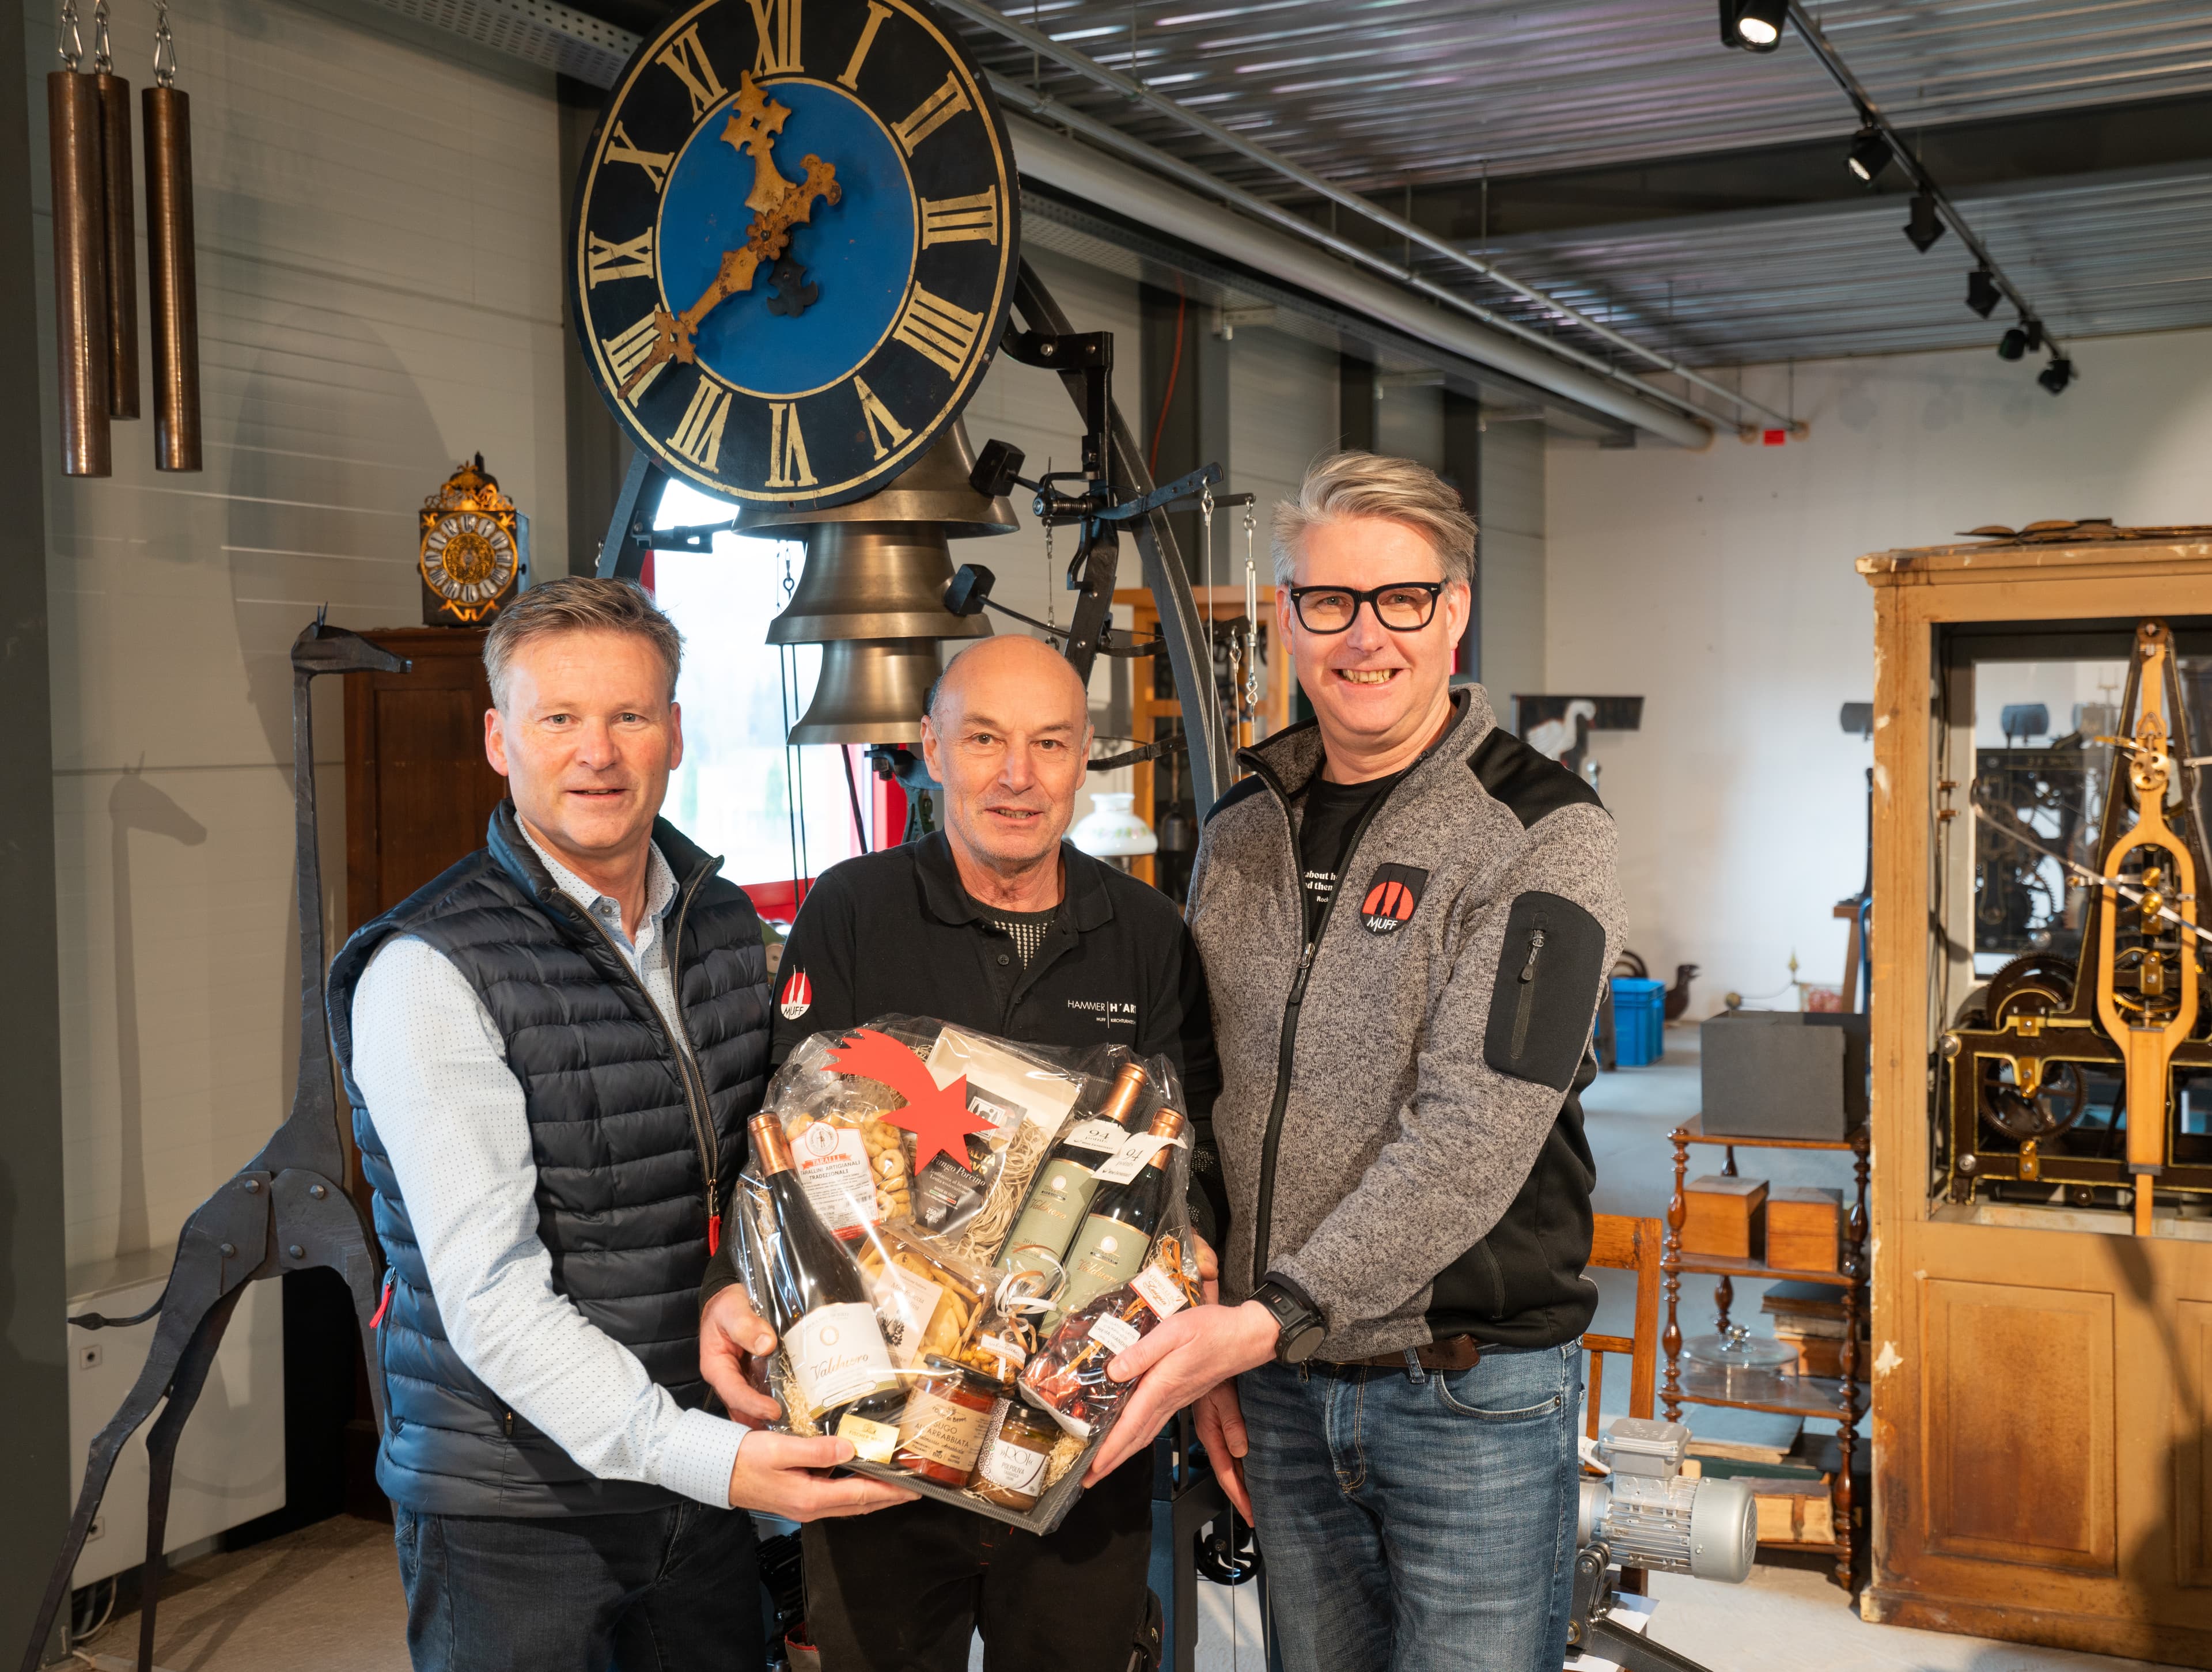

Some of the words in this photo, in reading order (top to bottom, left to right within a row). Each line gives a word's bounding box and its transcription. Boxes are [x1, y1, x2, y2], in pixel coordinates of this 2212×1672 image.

[746, 0, 804, 78] XII
[836, 0, 893, 91] I
[656, 22, 728, 123] XI
[891, 71, 972, 158] II
[604, 120, 675, 194] X
[921, 184, 998, 249] III
[589, 226, 653, 289] IX
[892, 280, 984, 382] IIII
[665, 374, 733, 474] VII
[853, 376, 912, 461] V
[766, 403, 817, 488] VI
[1305, 870, 1328, 881] about
[1331, 872, 1338, 881] h
[1367, 916, 1399, 932] MUFF
[783, 1006, 804, 1019] MUFF
[1067, 999, 1105, 1011] HAMMER
[1110, 1003, 1136, 1014] H'AR
[1089, 1129, 1110, 1140] 94
[1126, 1148, 1143, 1162] 94
[809, 1169, 849, 1180] TRADIZIONALI
[812, 1155, 840, 1166] TARALLI
[825, 1160, 861, 1171] ARTIGIANALI
[931, 1155, 956, 1174] Fungo
[956, 1166, 986, 1187] Porcino
[933, 1420, 957, 1434] SUGO
